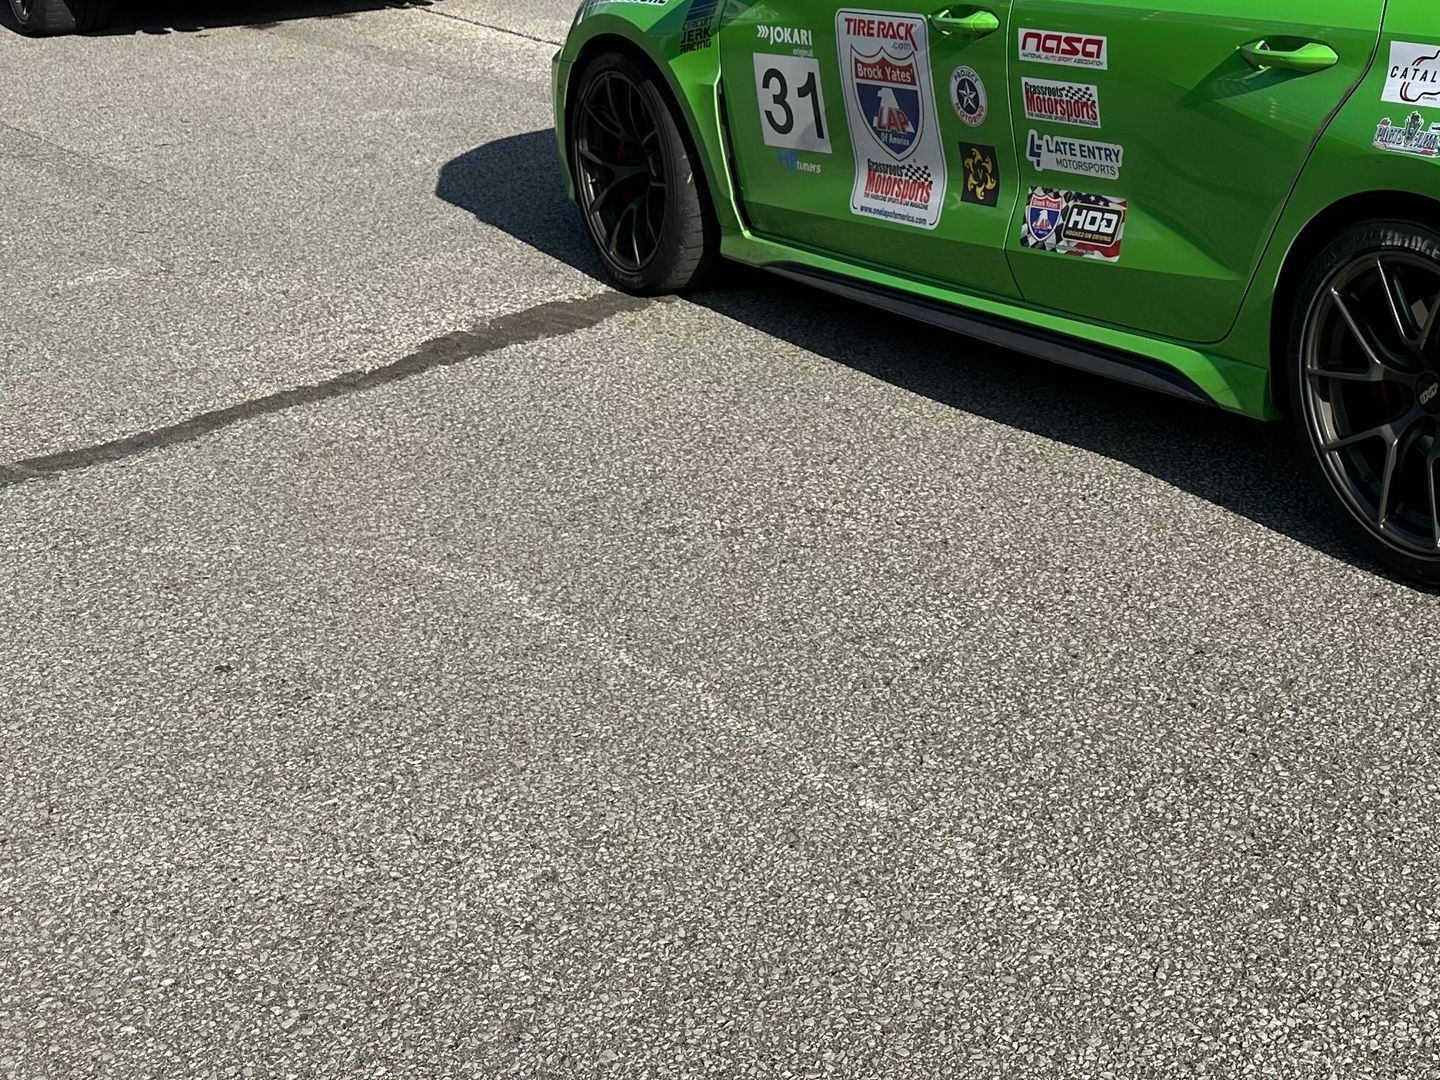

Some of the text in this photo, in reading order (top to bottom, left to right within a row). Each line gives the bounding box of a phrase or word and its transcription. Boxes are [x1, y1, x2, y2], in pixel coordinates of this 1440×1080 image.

[681, 27, 711, 44] JERK
[769, 26, 812, 46] JOKARI
[844, 18, 918, 51] TIRE RACK
[857, 63, 882, 80] Brock
[953, 68, 978, 84] PROJECT
[1024, 81, 1064, 98] Grassroots
[762, 68, 825, 139] 31
[1025, 92, 1098, 121] Motorsports
[1045, 139, 1121, 163] LATE ENTRY
[867, 159, 904, 177] Grassroots
[1056, 157, 1117, 176] MOTORSPORTS
[865, 169, 932, 204] Motorsports
